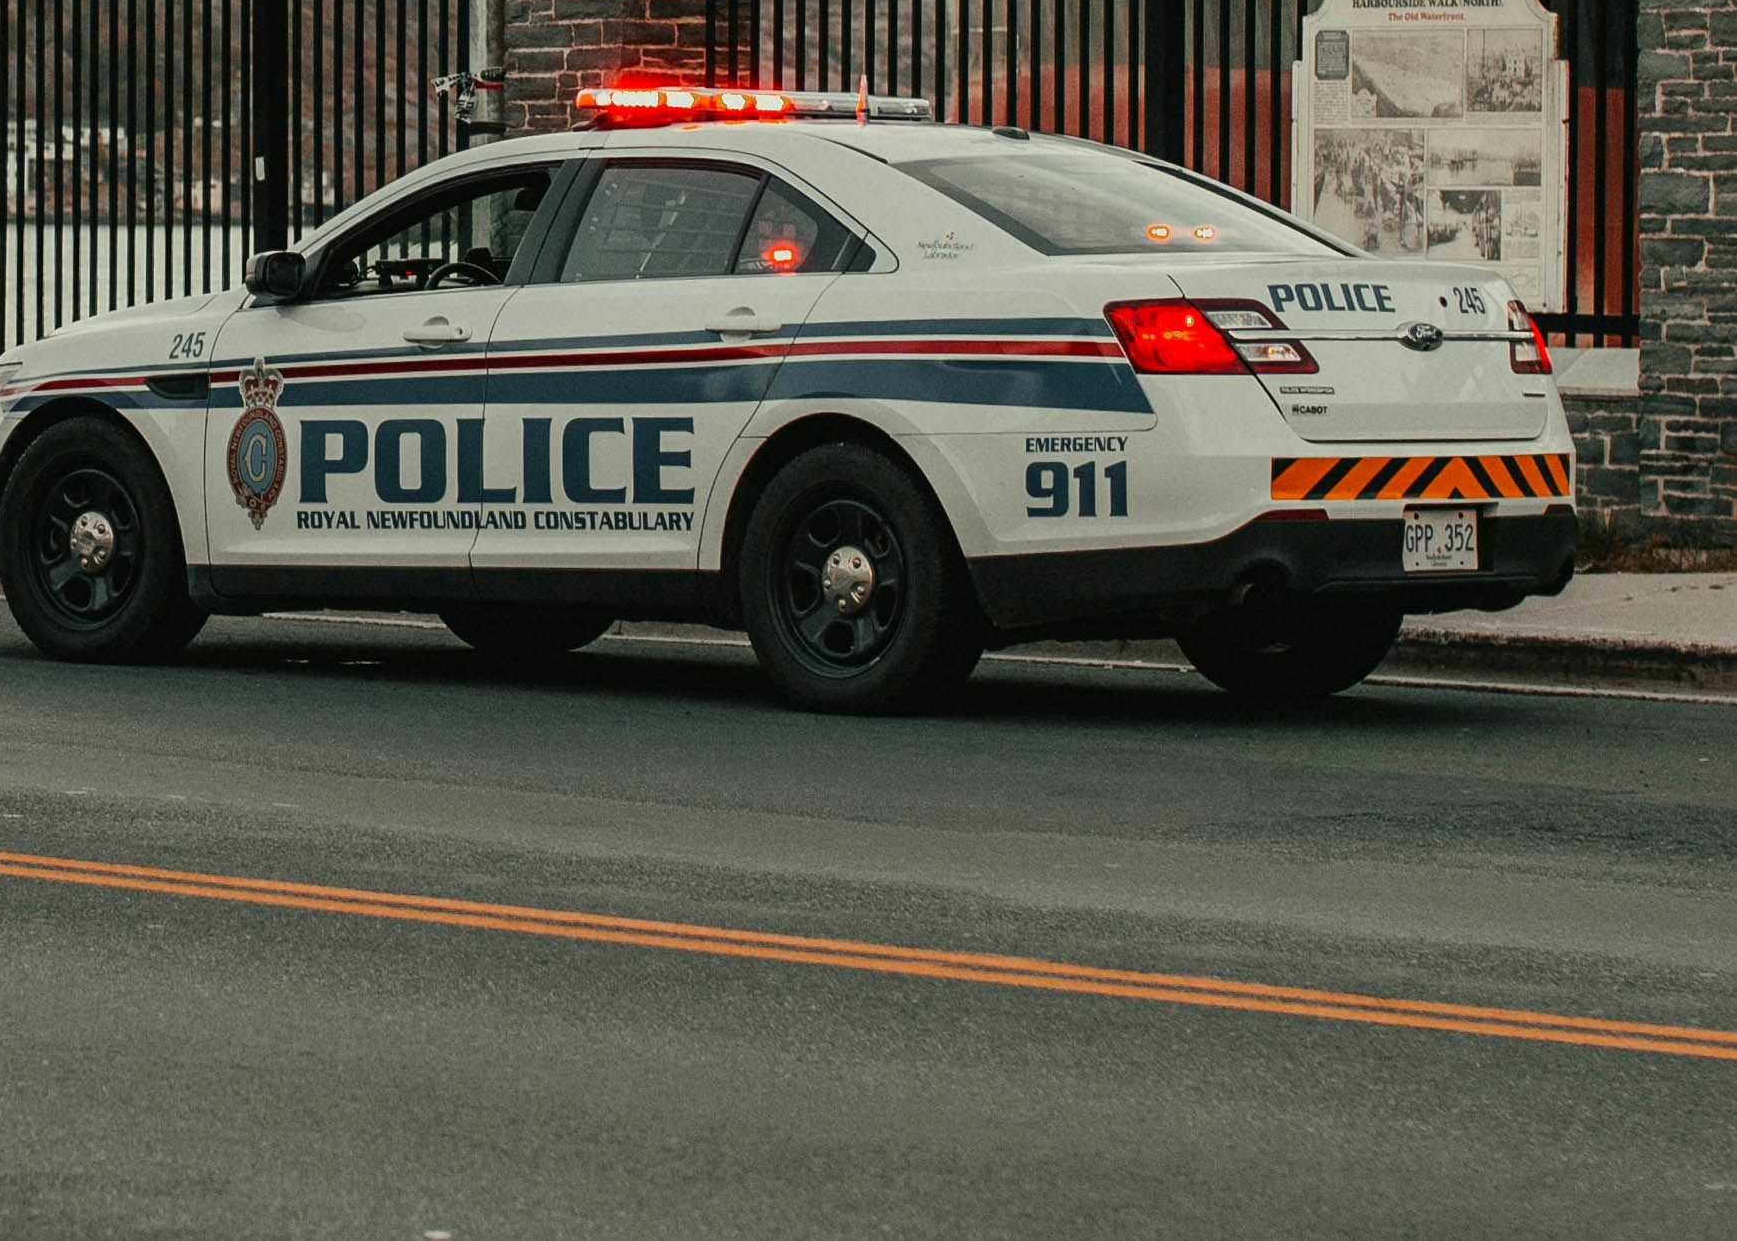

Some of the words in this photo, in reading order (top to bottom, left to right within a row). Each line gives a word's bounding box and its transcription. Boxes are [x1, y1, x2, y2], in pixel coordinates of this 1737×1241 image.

[1388, 12, 1403, 21] The
[1404, 12, 1419, 21] Old
[1267, 283, 1396, 313] POLICE
[1453, 287, 1486, 314] 245
[169, 331, 206, 359] 245
[1299, 405, 1328, 415] CABOT
[1025, 436, 1129, 453] EMERGENCY
[299, 416, 695, 504] POLICE
[1025, 460, 1129, 517] 911
[297, 511, 360, 530] ROYAL
[367, 510, 527, 530] NEWFOUNDLAND
[534, 510, 695, 531] CONSTABULARY
[1405, 524, 1434, 553] GPP
[1444, 523, 1475, 552] 352
